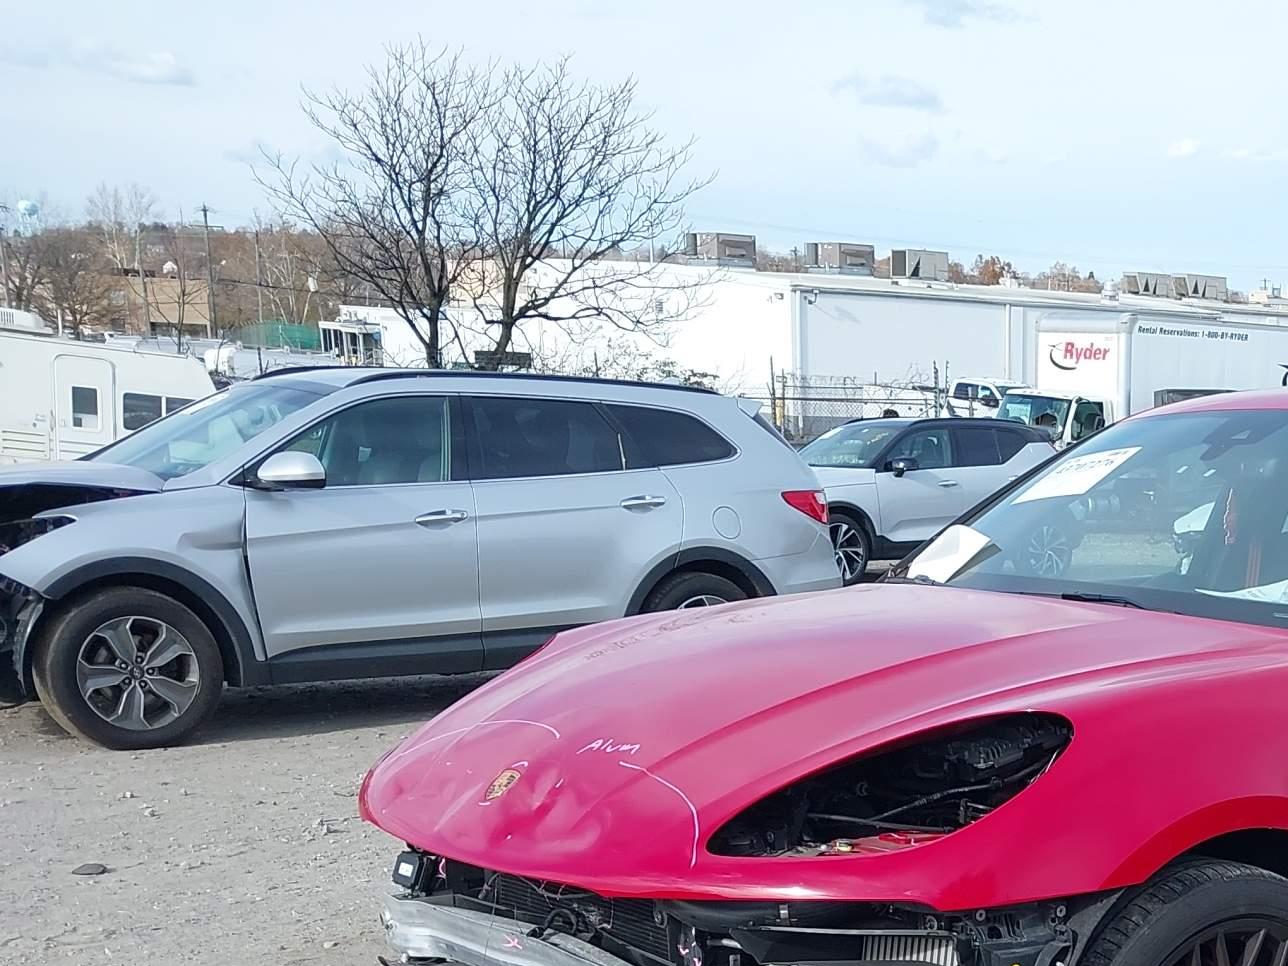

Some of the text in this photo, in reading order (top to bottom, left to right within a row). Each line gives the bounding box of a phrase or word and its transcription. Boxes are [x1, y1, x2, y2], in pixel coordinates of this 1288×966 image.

[1138, 325, 1158, 335] Rental
[1160, 327, 1200, 338] Reservations:
[1063, 341, 1111, 365] Ryder
